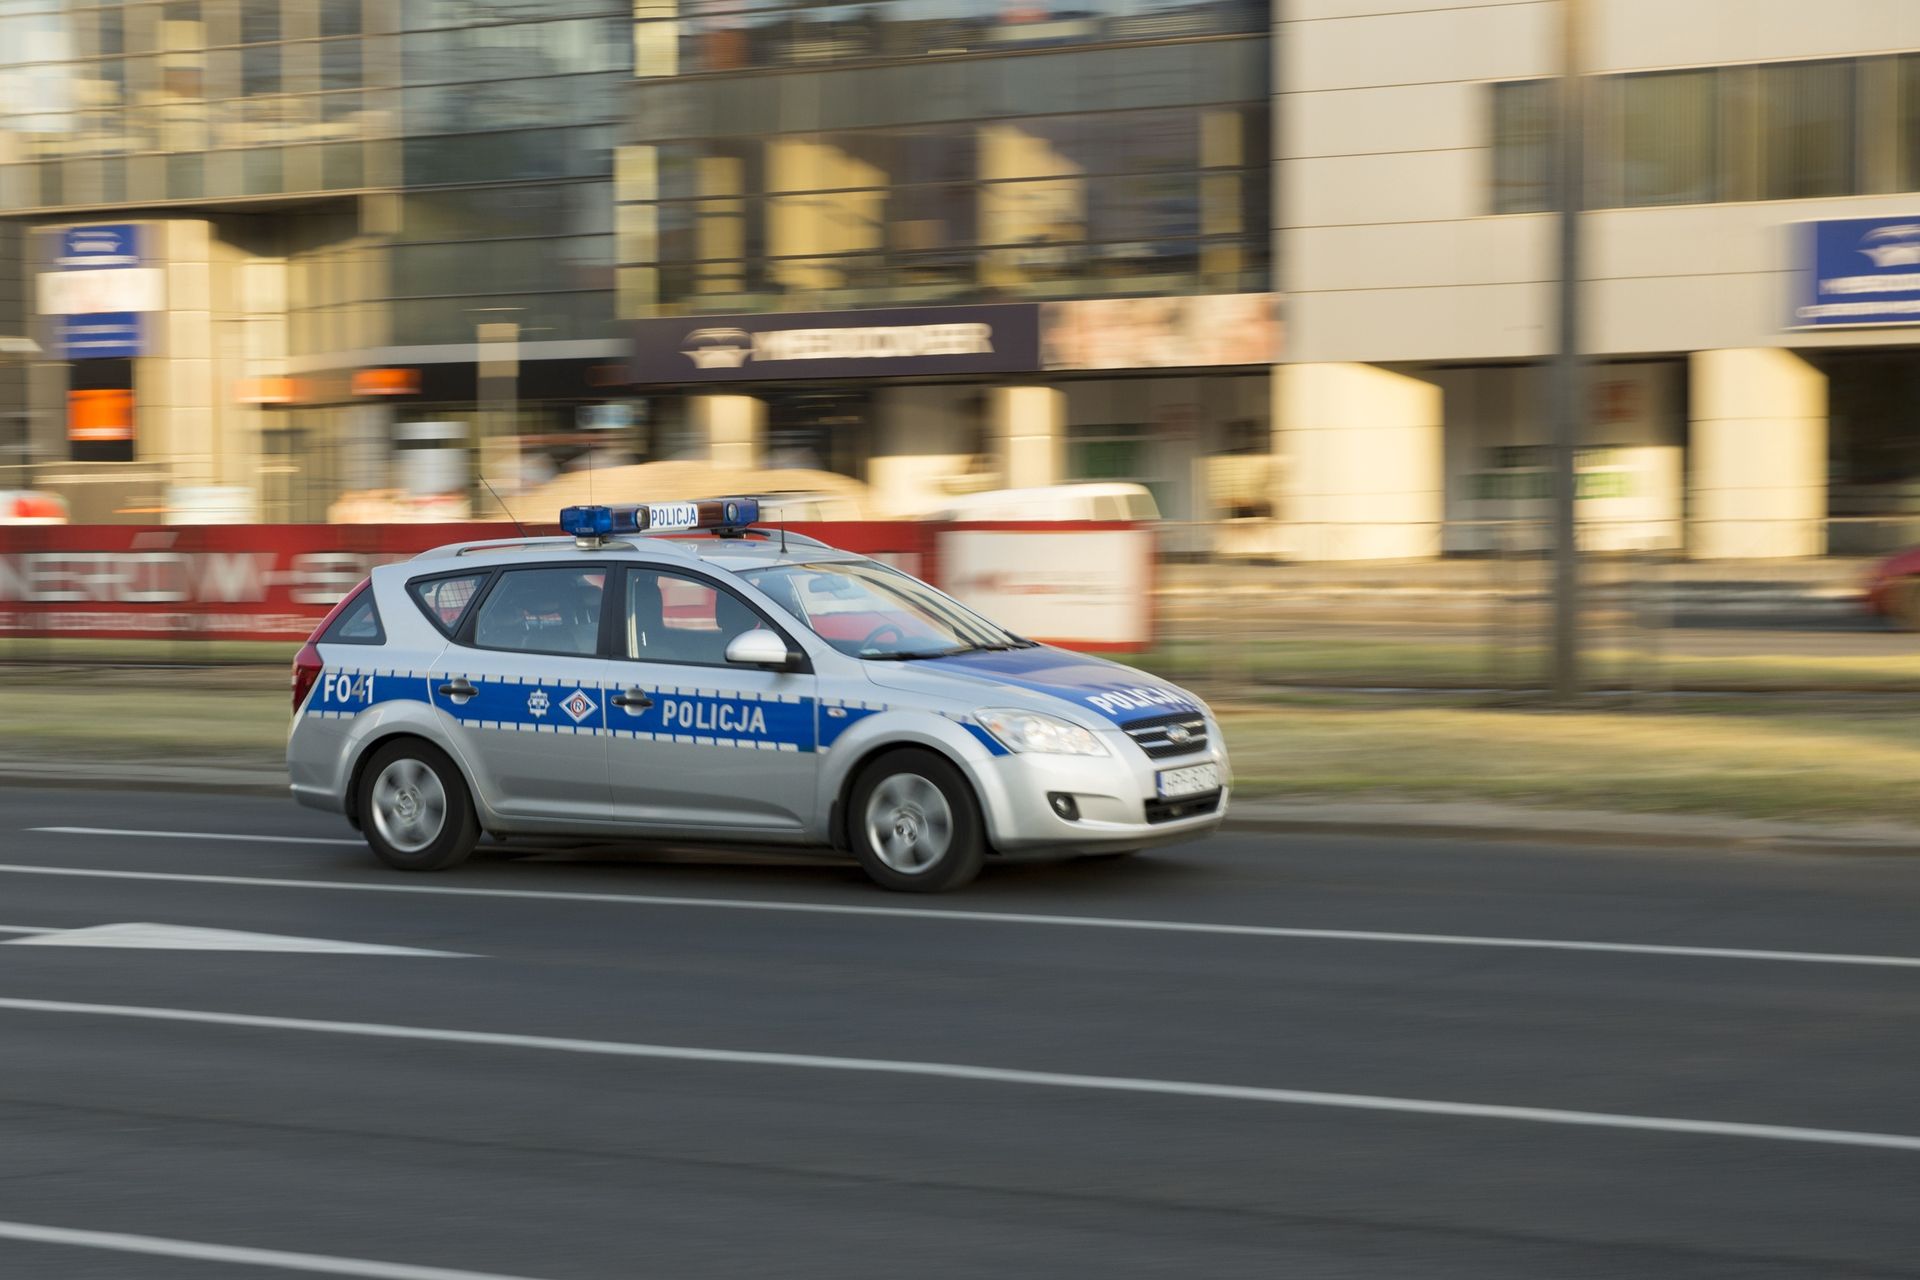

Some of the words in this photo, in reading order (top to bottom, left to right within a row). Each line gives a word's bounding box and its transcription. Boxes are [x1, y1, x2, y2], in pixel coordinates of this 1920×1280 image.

[651, 507, 697, 527] POLICJA
[1084, 687, 1194, 715] POLICJA
[662, 699, 767, 734] POLICJA
